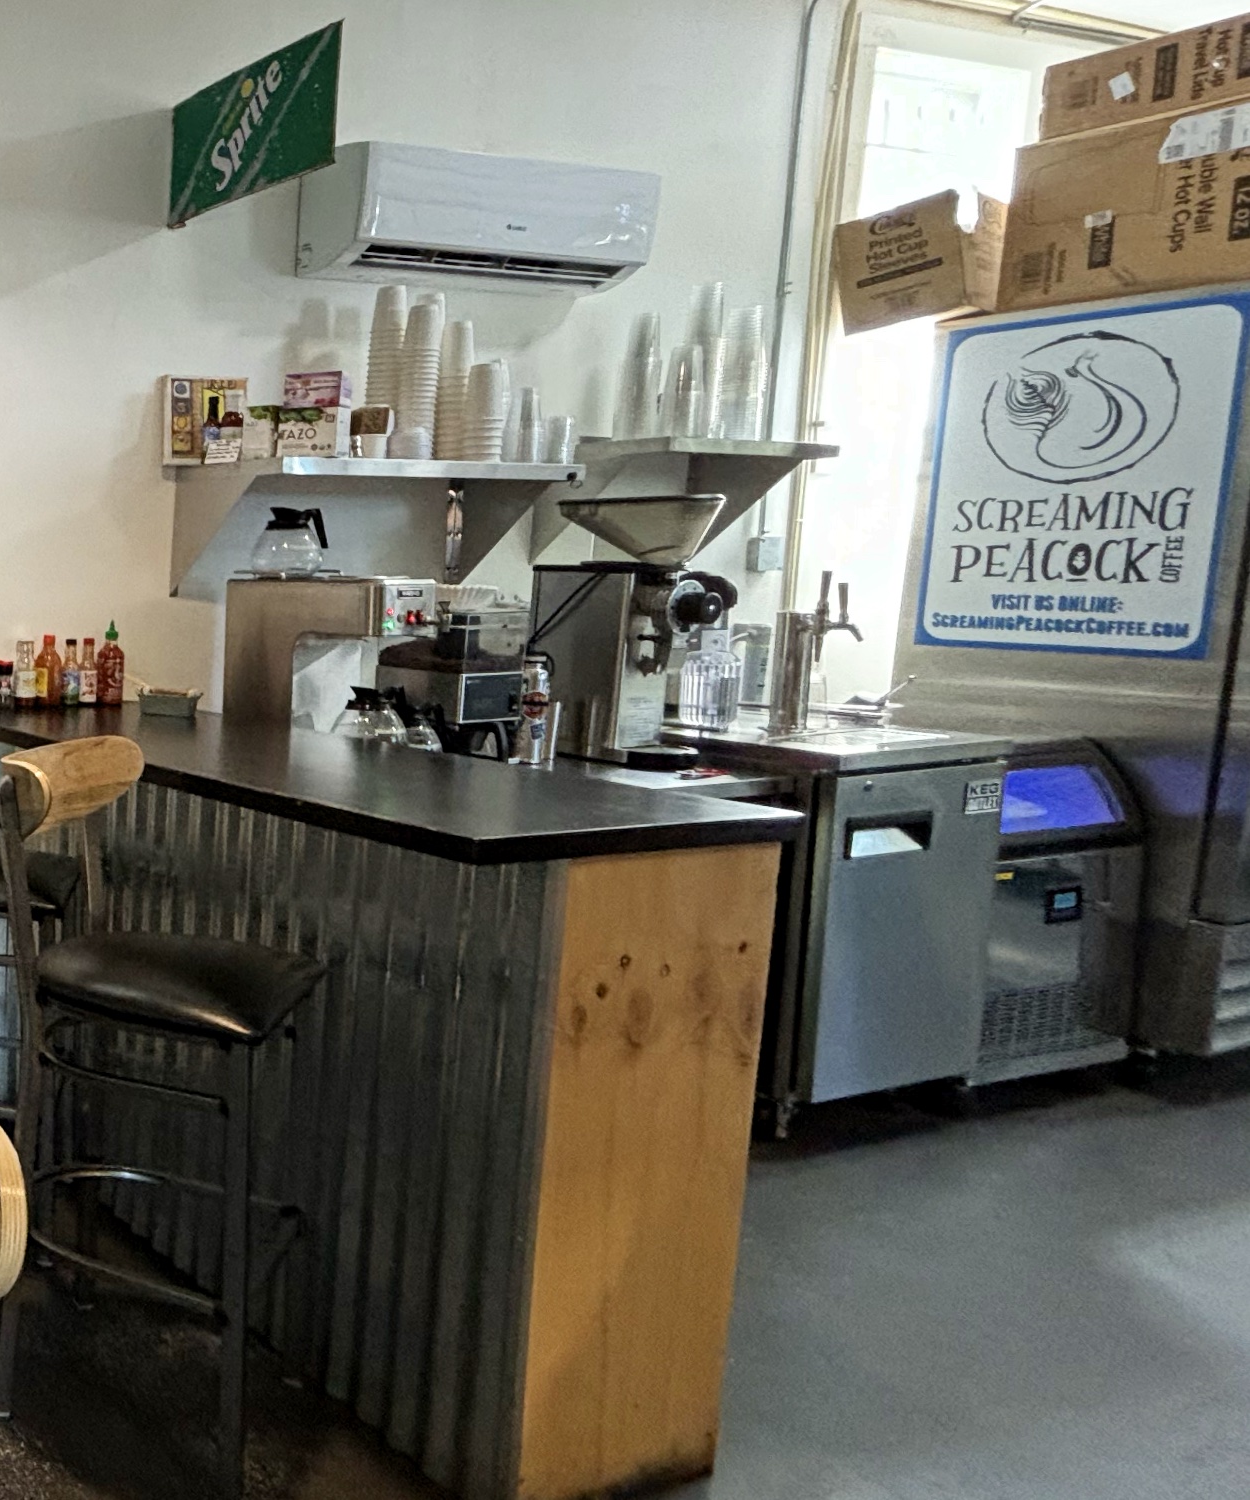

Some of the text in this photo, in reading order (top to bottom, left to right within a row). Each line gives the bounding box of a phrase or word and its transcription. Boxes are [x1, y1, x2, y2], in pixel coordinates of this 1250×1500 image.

[1192, 26, 1213, 70] Travel
[1216, 29, 1234, 55] Hot
[210, 60, 283, 192] Sprite
[1174, 174, 1196, 207] Hot
[1166, 208, 1191, 253] Cups
[1193, 196, 1216, 234] Wall
[866, 239, 929, 264] Hot Cup
[869, 226, 923, 252] Printed
[868, 251, 928, 274] Sleeves
[280, 427, 317, 440] TAZO
[951, 486, 1195, 535] SCREAMING
[949, 537, 1163, 584] PEACOCK
[1158, 534, 1186, 584] COFFEE
[990, 593, 1124, 614] VISIT US ONLINE:
[970, 782, 1000, 795] KEG
